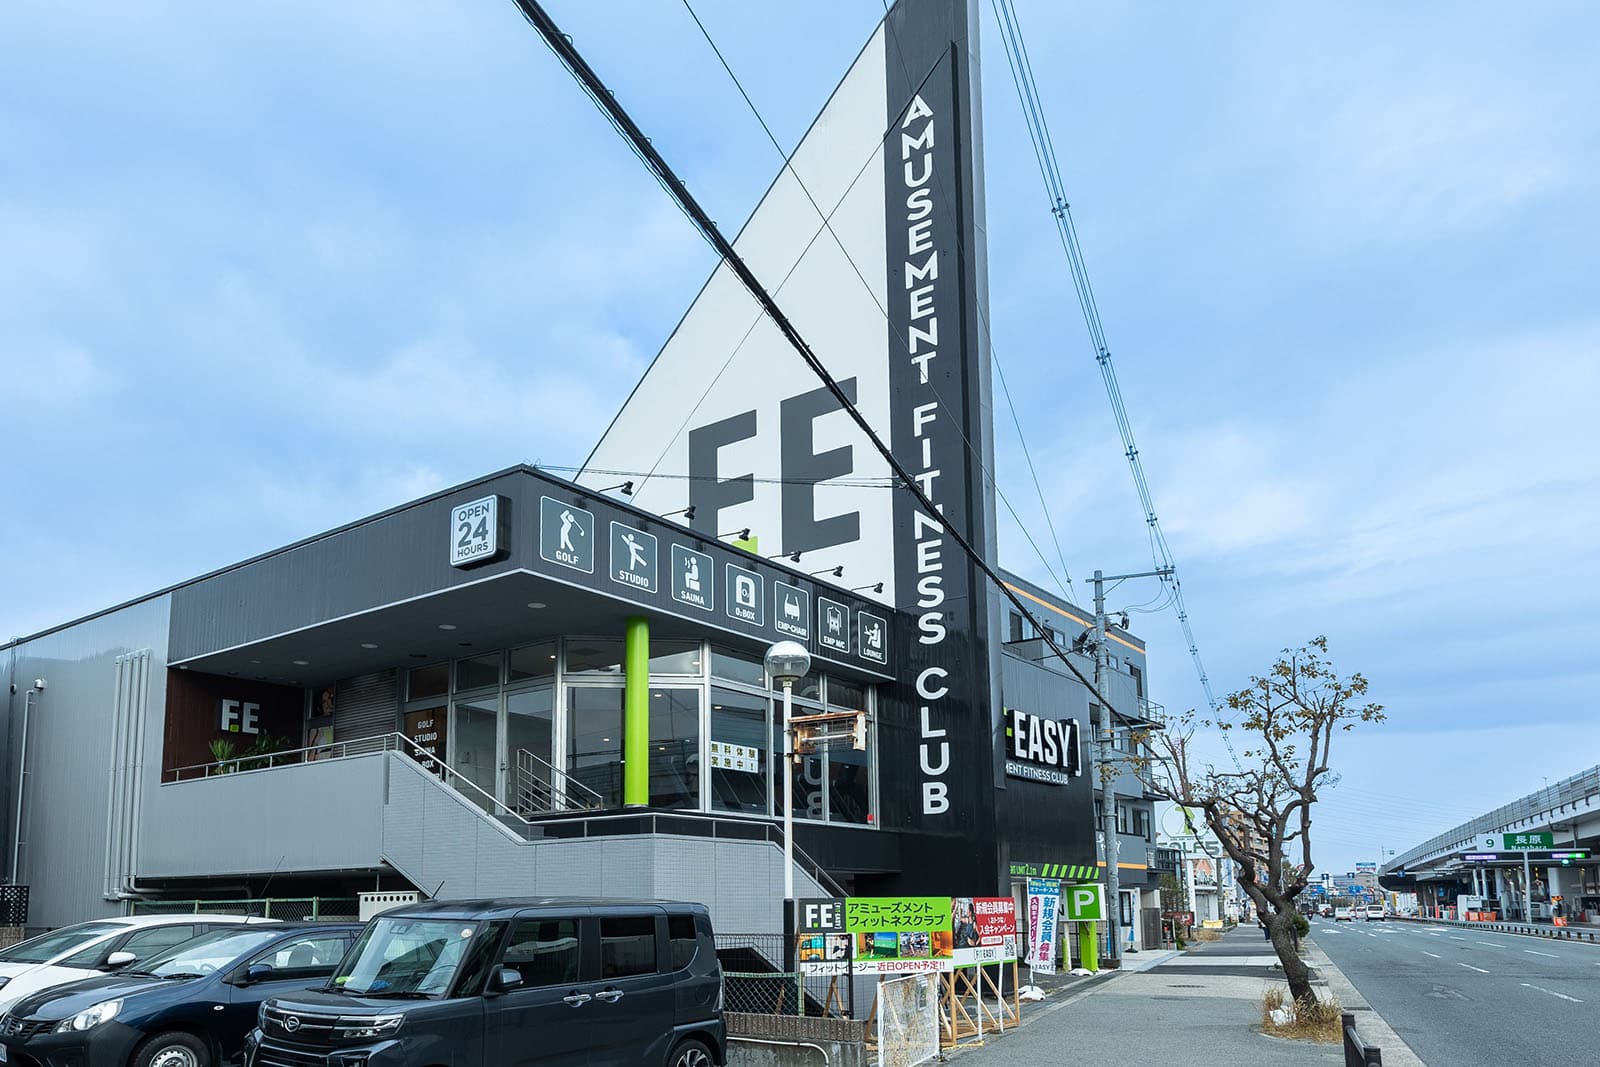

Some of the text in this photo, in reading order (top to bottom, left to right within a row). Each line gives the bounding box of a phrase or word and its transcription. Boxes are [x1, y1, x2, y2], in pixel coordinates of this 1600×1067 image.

[901, 93, 950, 815] AMUSEMENT FITNESS CLUB
[458, 503, 489, 522] OPEN
[457, 517, 488, 548] 24
[457, 542, 488, 558] HOURS
[556, 550, 579, 565] GOLF
[619, 570, 649, 587] STUDIO
[681, 591, 704, 605] SAUNA
[418, 719, 434, 729] GOLF
[414, 732, 437, 743] STUDIO
[711, 743, 756, 758] 無料体験
[1023, 766, 1050, 781] FITNESS
[1051, 772, 1068, 784] CLUB
[1486, 839, 1495, 848] 9
[1515, 835, 1542, 844] 長原
[848, 902, 933, 914] アミューズメント
[1073, 890, 1095, 917] P
[849, 914, 945, 927] フィットネスクラブ
[980, 923, 1015, 935] 入会キャンペーン
[877, 961, 945, 972] 近日OPEN予定!!
